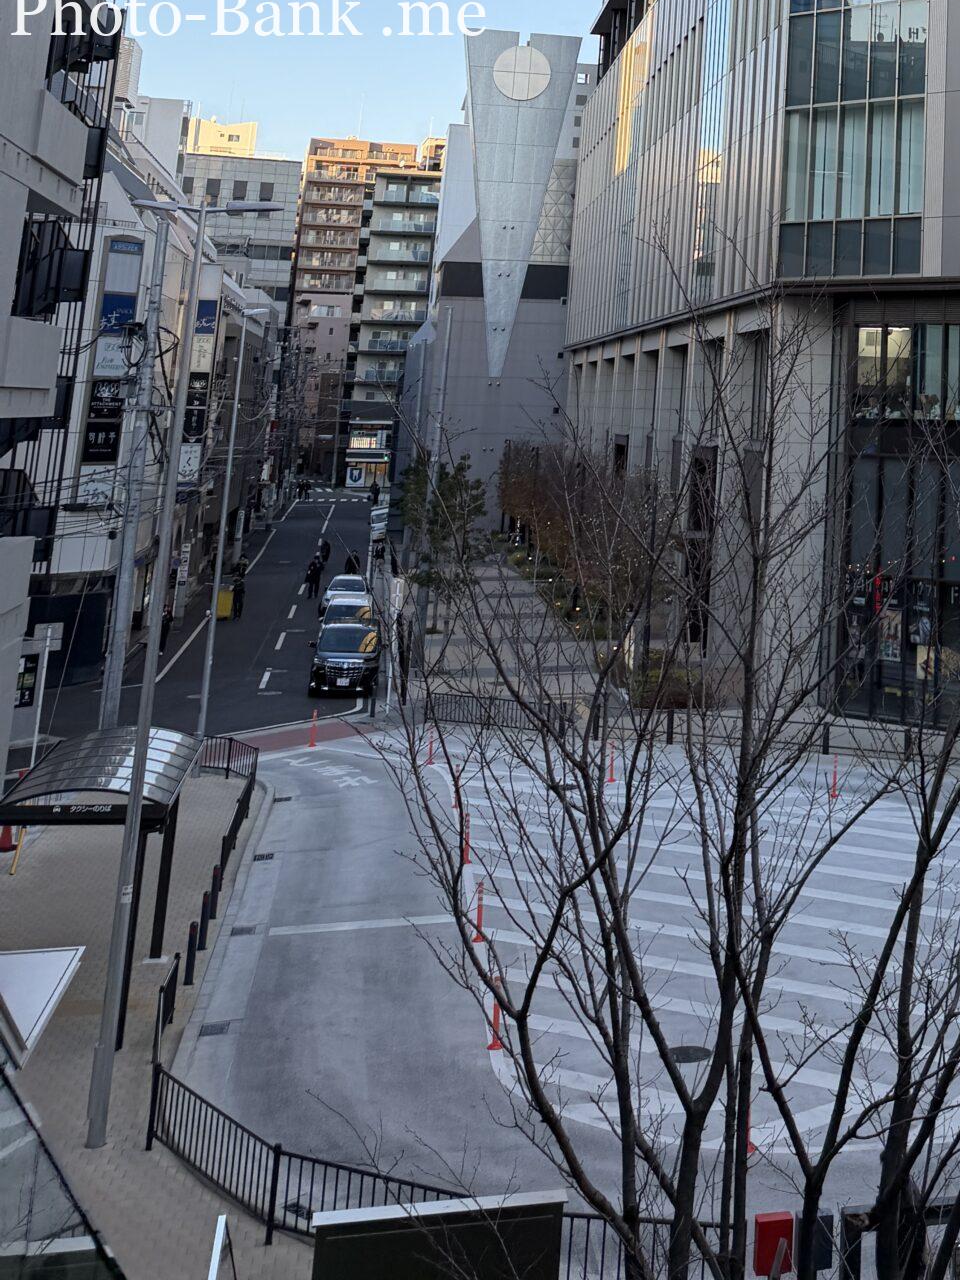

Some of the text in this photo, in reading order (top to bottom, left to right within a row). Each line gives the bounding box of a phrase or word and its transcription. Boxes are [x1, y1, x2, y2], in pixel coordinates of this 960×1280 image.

[69, 805, 112, 813] タクシーのりば
